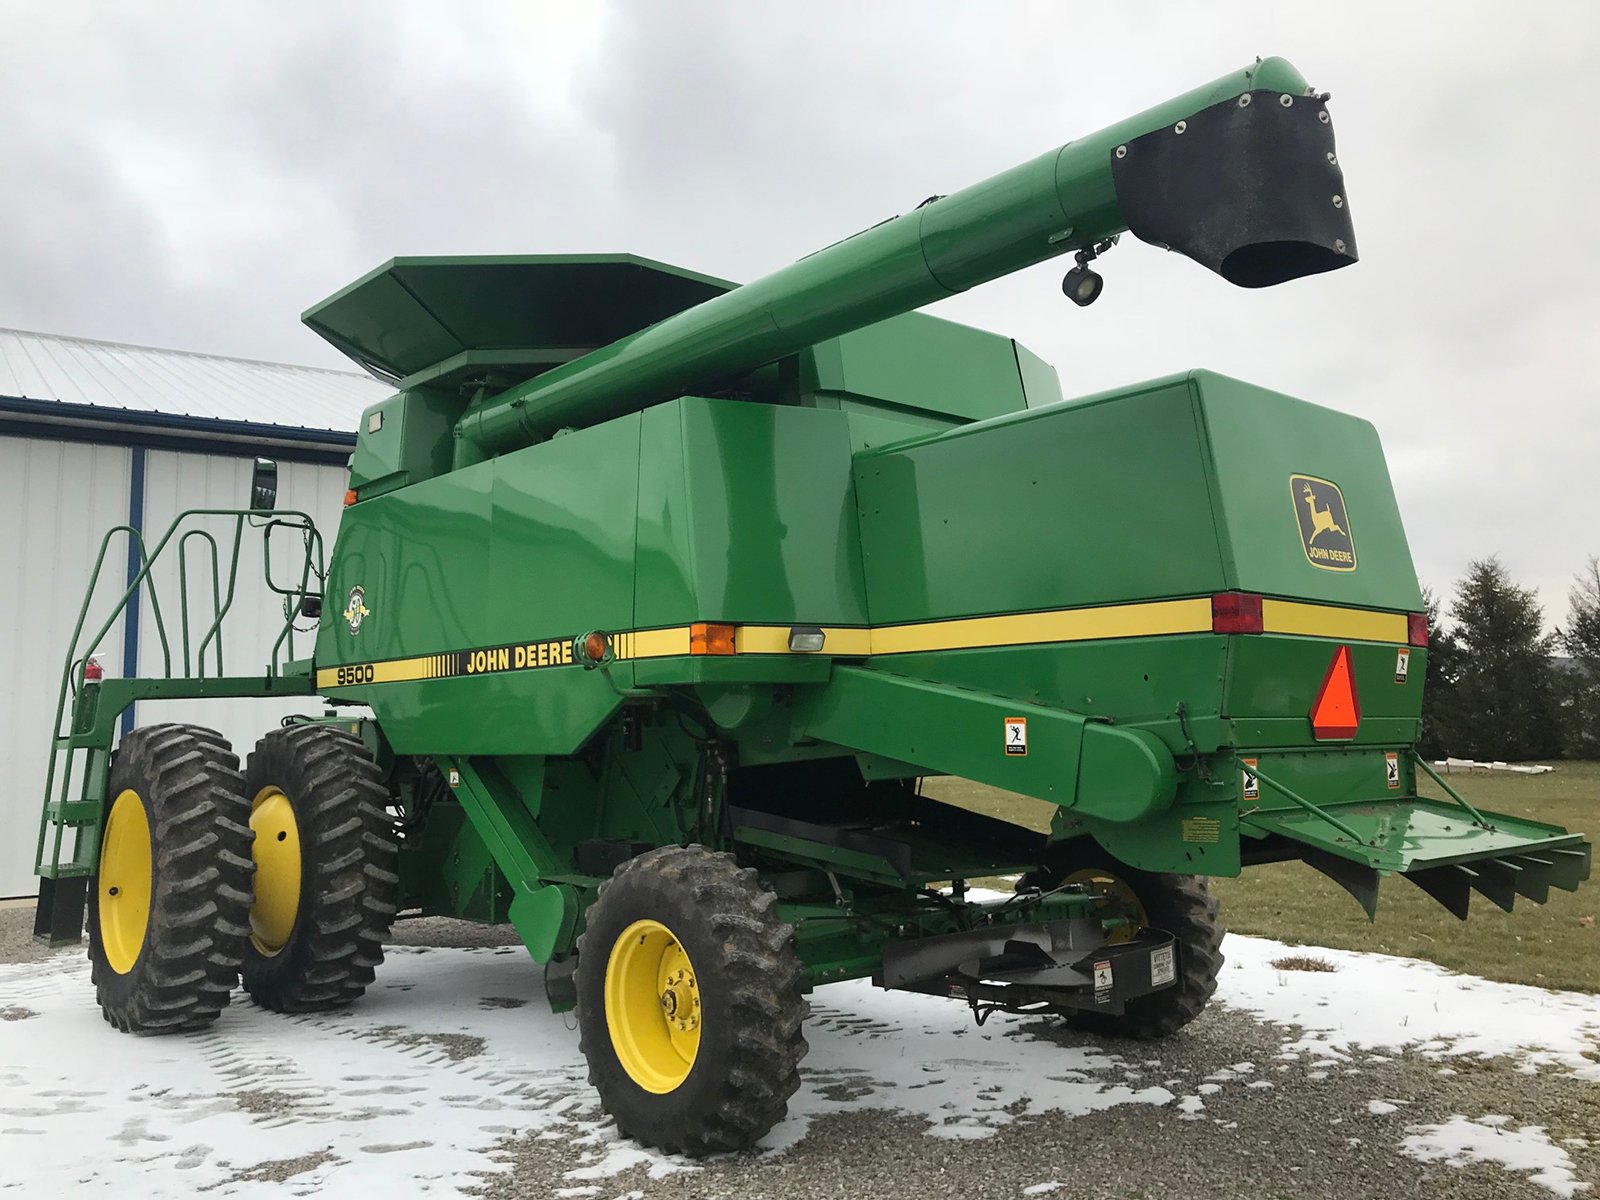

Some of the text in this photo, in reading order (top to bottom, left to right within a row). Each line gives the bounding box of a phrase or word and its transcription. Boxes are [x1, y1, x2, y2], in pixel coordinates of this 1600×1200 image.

[1309, 546, 1353, 563] JOHN DEERE
[337, 640, 573, 685] 9500 JOHN DEERE
